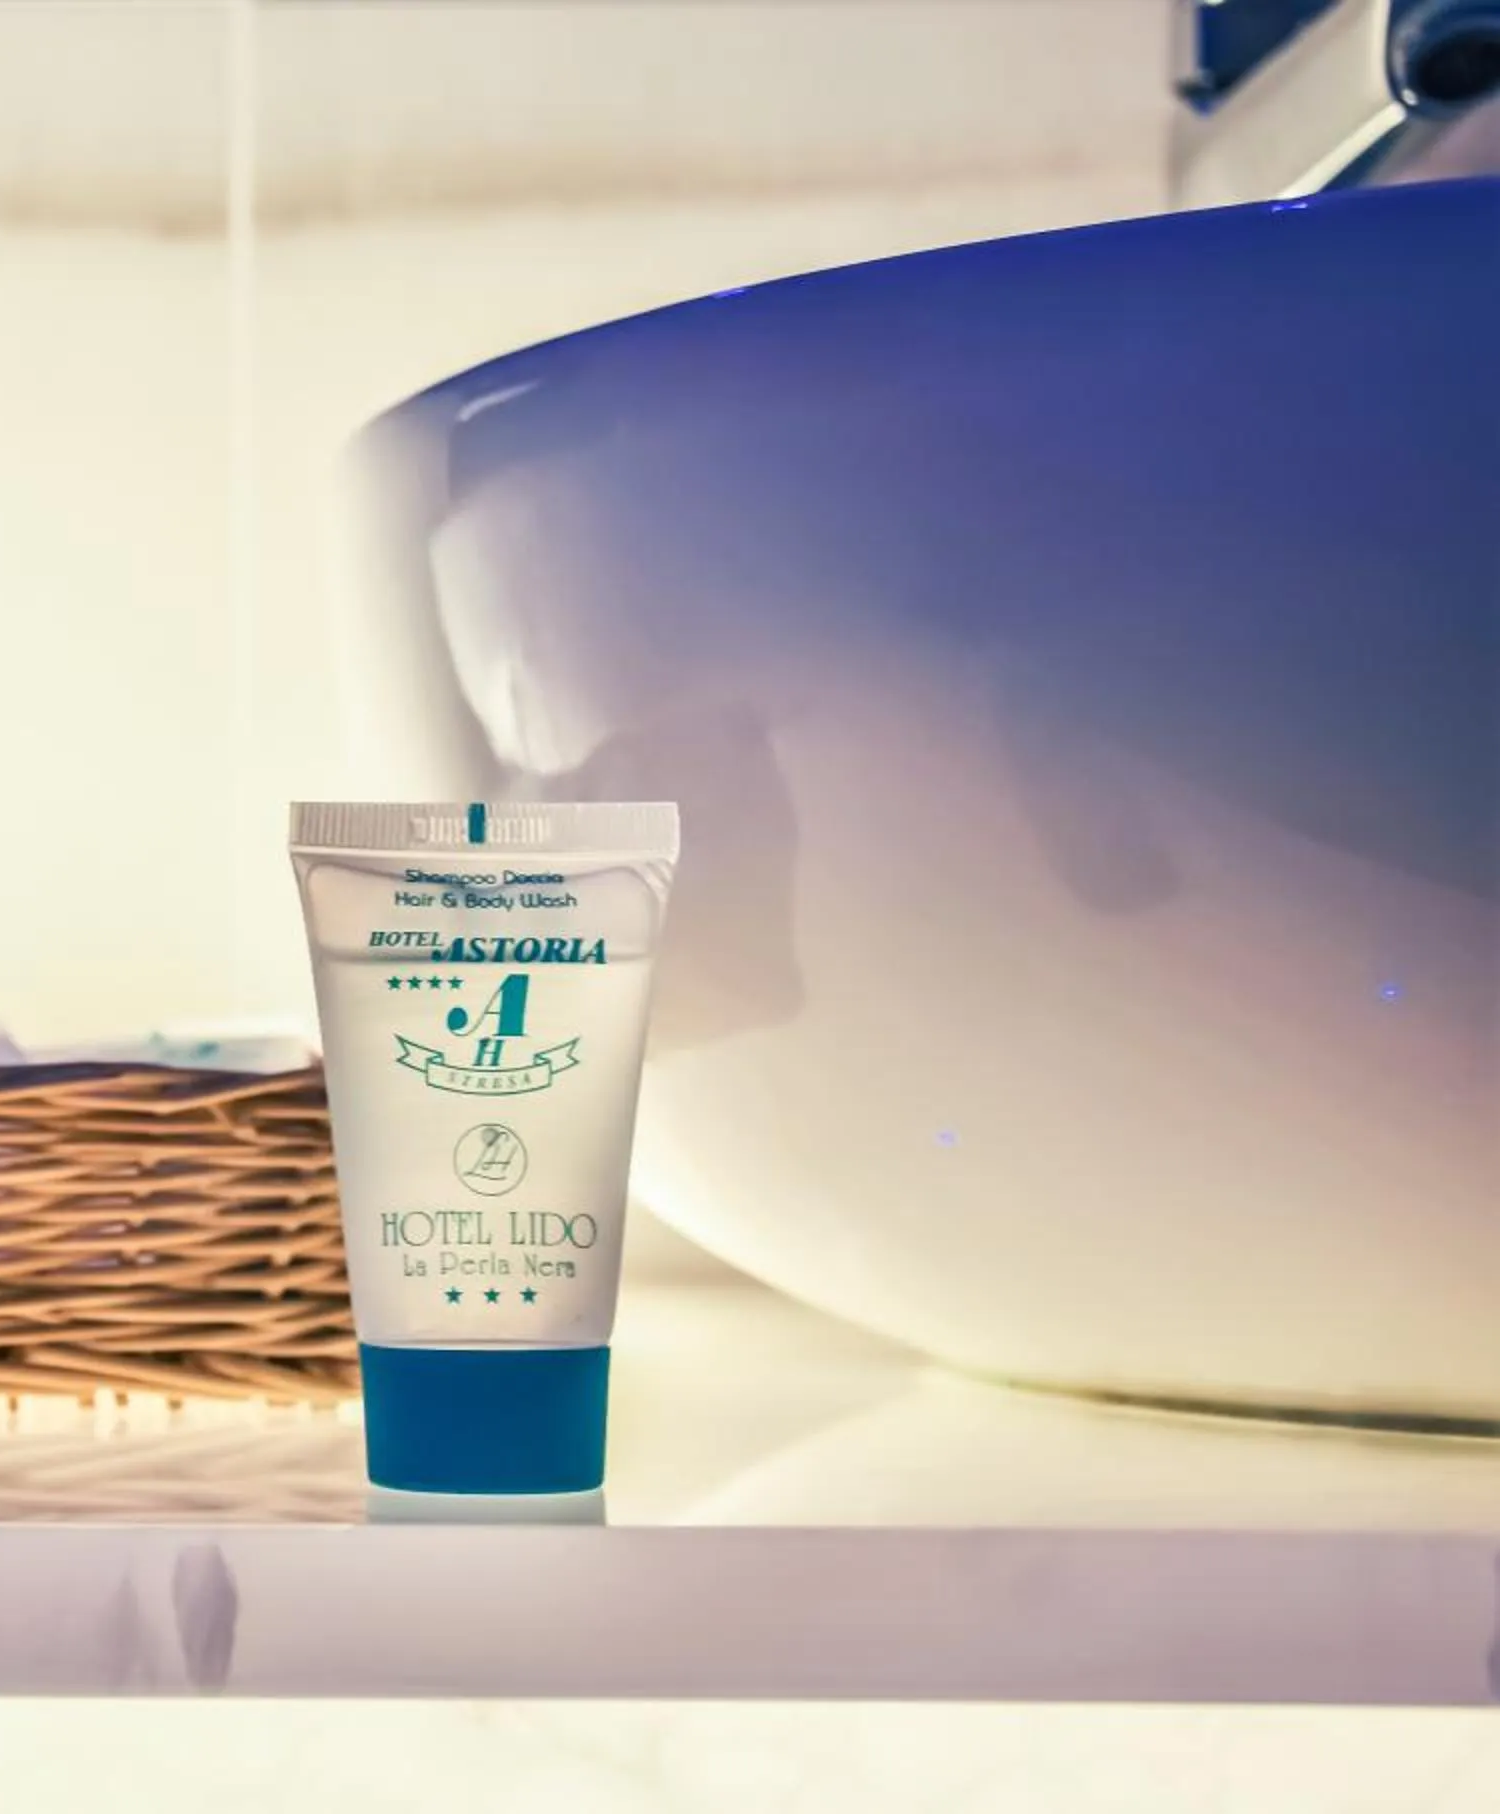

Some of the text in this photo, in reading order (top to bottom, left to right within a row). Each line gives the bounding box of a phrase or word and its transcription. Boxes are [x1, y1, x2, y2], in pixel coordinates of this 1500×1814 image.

[404, 868, 497, 889] Shampoo
[394, 891, 578, 912] Hair & Body Wash
[369, 931, 607, 964] HOTEL ASTORIA
[471, 1037, 506, 1067] H
[380, 1211, 598, 1249] HOTEL LIDO
[403, 1252, 577, 1278] La Perla Nera
